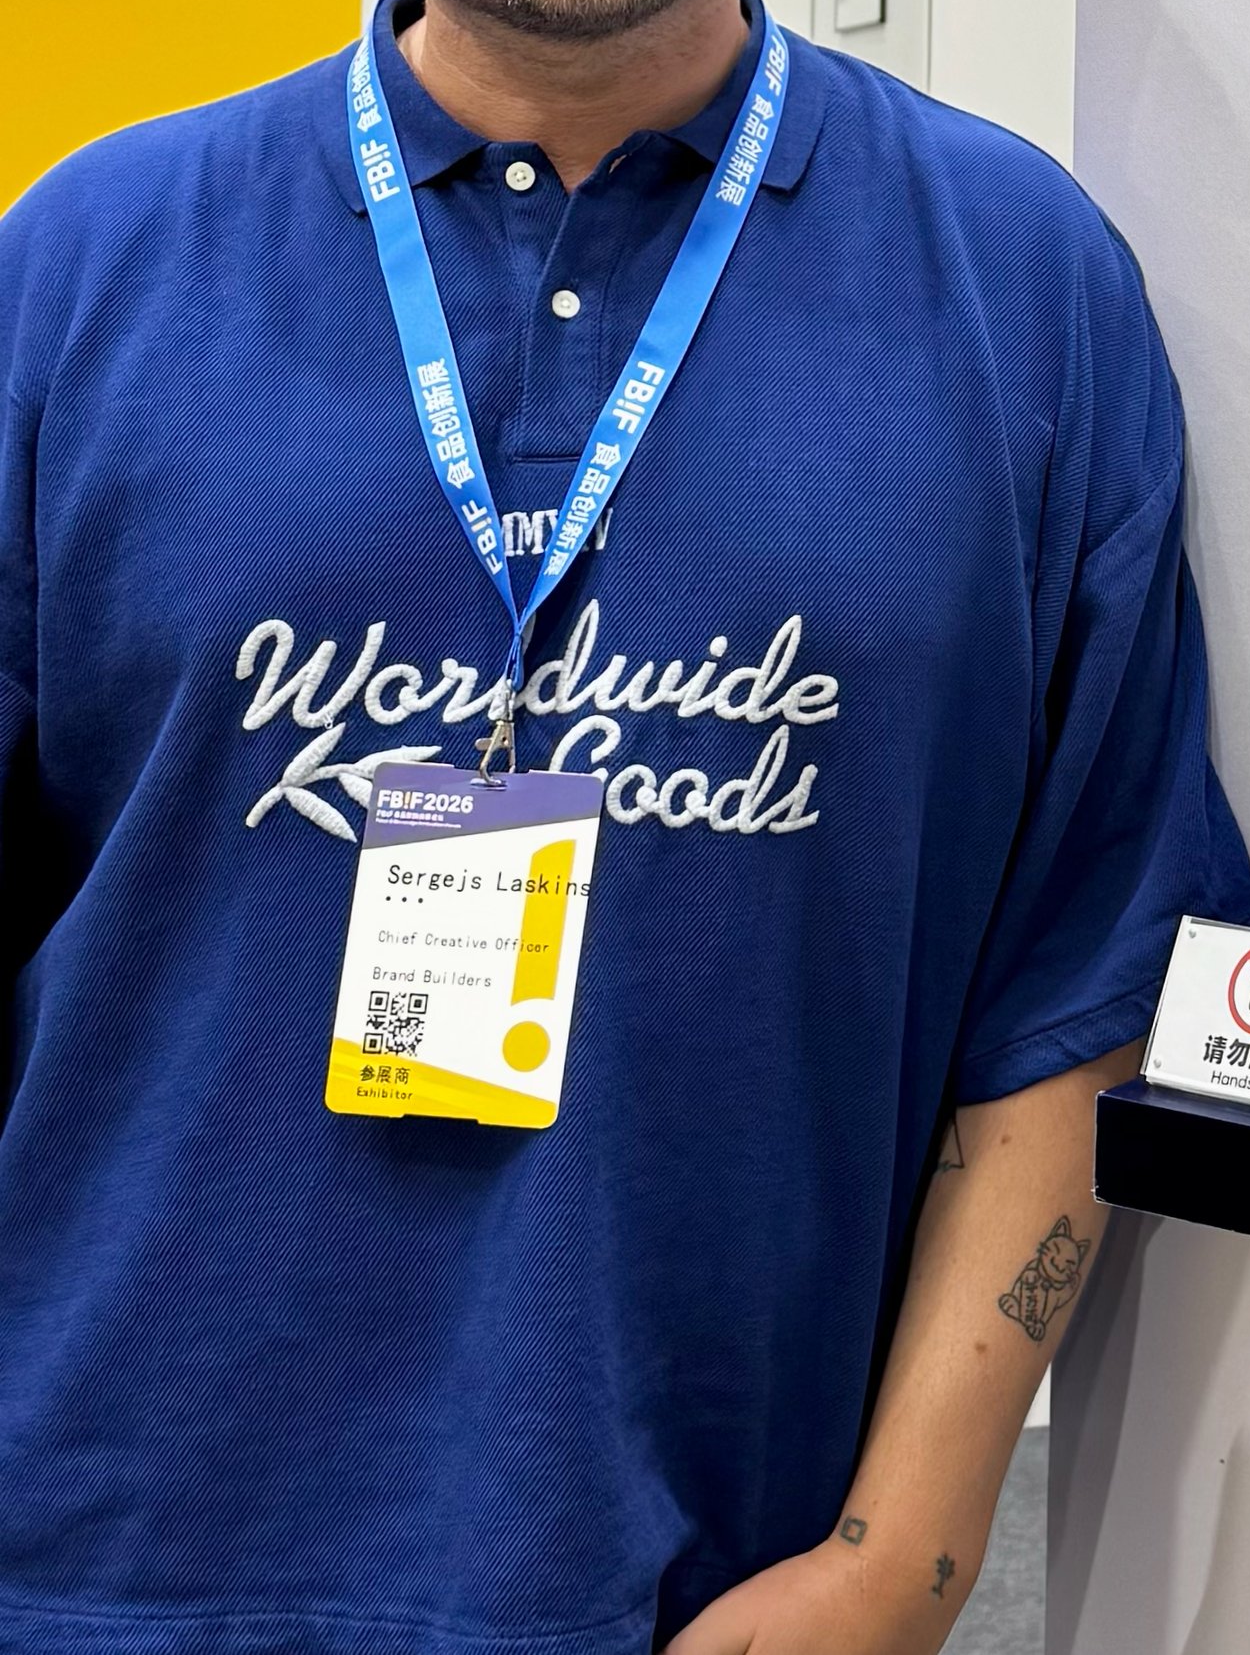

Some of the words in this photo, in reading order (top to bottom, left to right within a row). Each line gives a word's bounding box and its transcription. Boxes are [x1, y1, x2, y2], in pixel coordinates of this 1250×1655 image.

[715, 93, 775, 206] 食品创新展
[417, 357, 475, 490] 食品创新展
[543, 441, 621, 576] 食品创新展
[387, 864, 482, 892] Sergejs
[496, 871, 590, 897] Laskins
[378, 930, 418, 946] Chief
[424, 933, 487, 950] Creative
[495, 938, 550, 954] Officer
[372, 966, 415, 983] Brand
[423, 970, 492, 988] Builders
[360, 1064, 411, 1085] 参展商
[356, 1086, 413, 1101] Exhibitor
